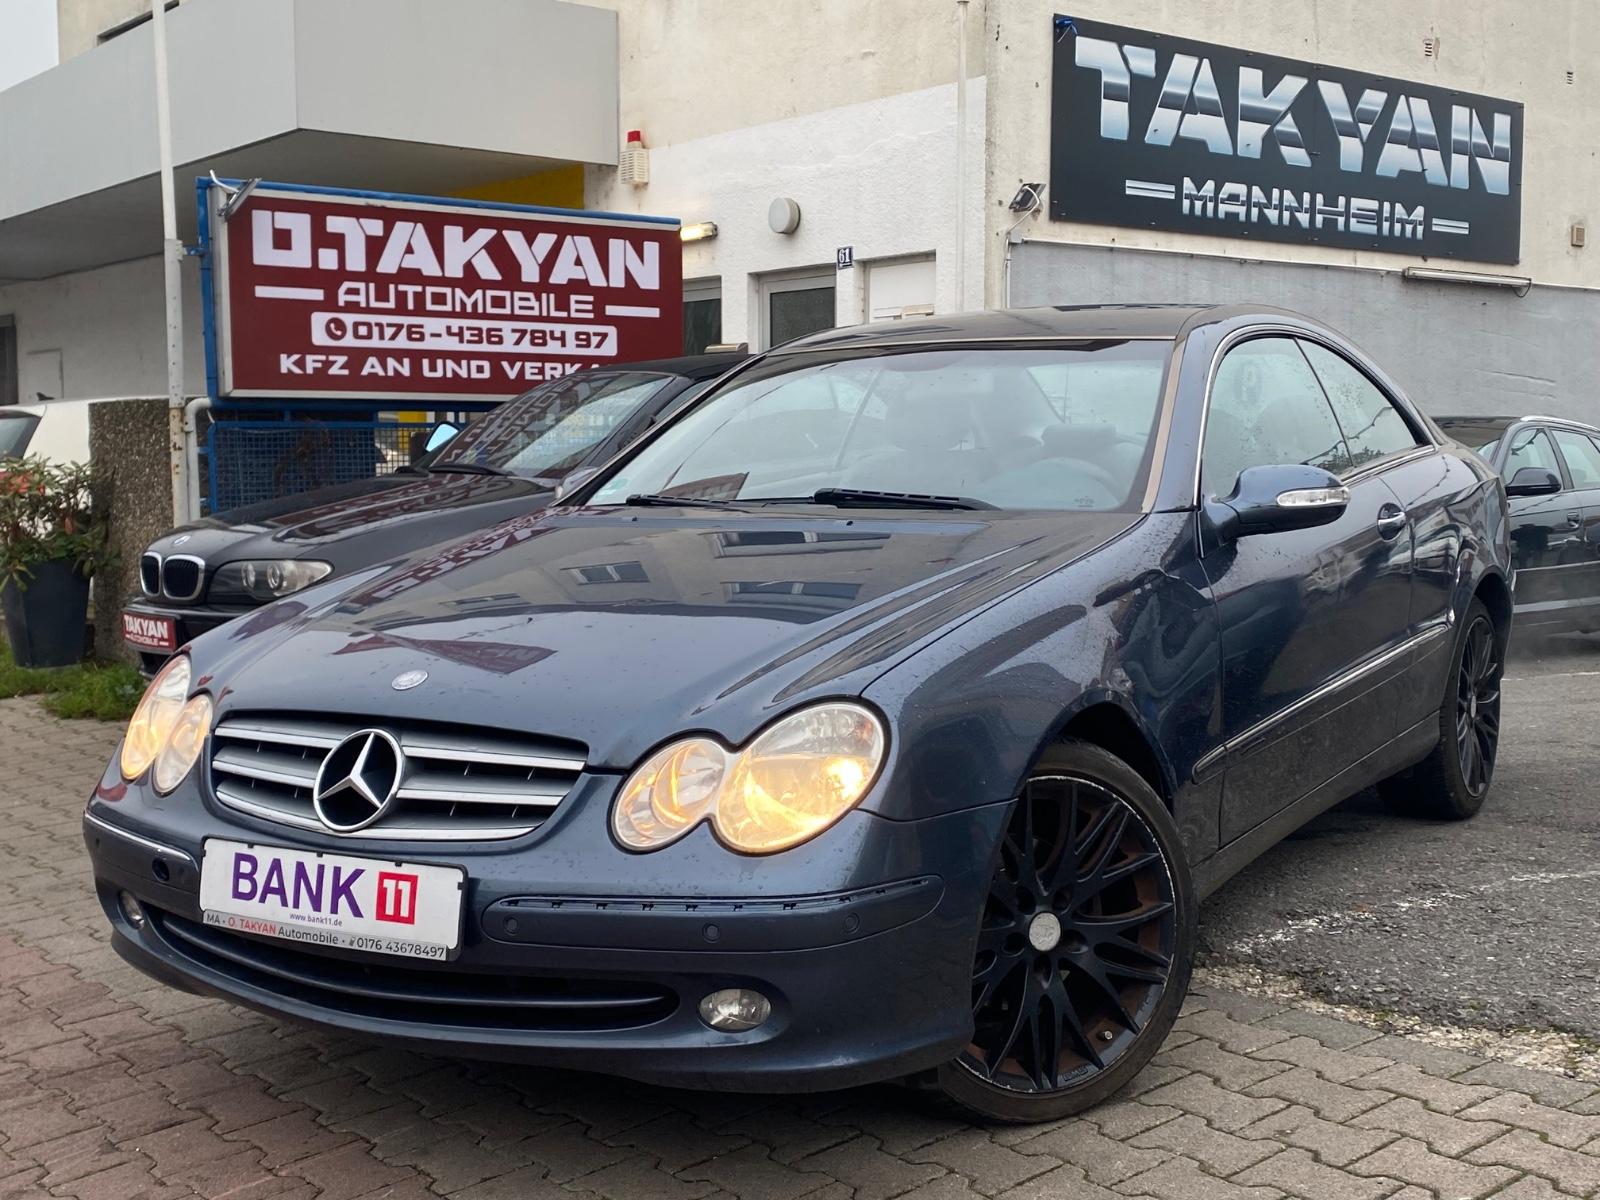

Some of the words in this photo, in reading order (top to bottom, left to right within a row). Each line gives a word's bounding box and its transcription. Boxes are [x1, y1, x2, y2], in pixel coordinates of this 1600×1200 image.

[1075, 36, 1511, 195] TAKYAN
[1182, 176, 1425, 240] MANNHEIM
[840, 248, 850, 262] 61
[337, 280, 595, 320] AUTOMOBILE
[352, 321, 504, 347] 0176-436
[511, 327, 567, 349] 784
[574, 331, 609, 350] 97
[280, 353, 349, 376] KFZ
[361, 357, 411, 378] AN
[422, 358, 491, 380] UND
[500, 361, 600, 381] VERK
[124, 614, 168, 639] TAKYAN
[231, 852, 366, 919] BANK
[383, 879, 411, 918] 11
[206, 913, 221, 925] MA
[240, 918, 277, 935] TAKYAN
[278, 926, 339, 946] Automobile
[356, 937, 383, 951] 0176
[385, 941, 445, 958] 43678497
[289, 912, 343, 927] www.bank11.de
